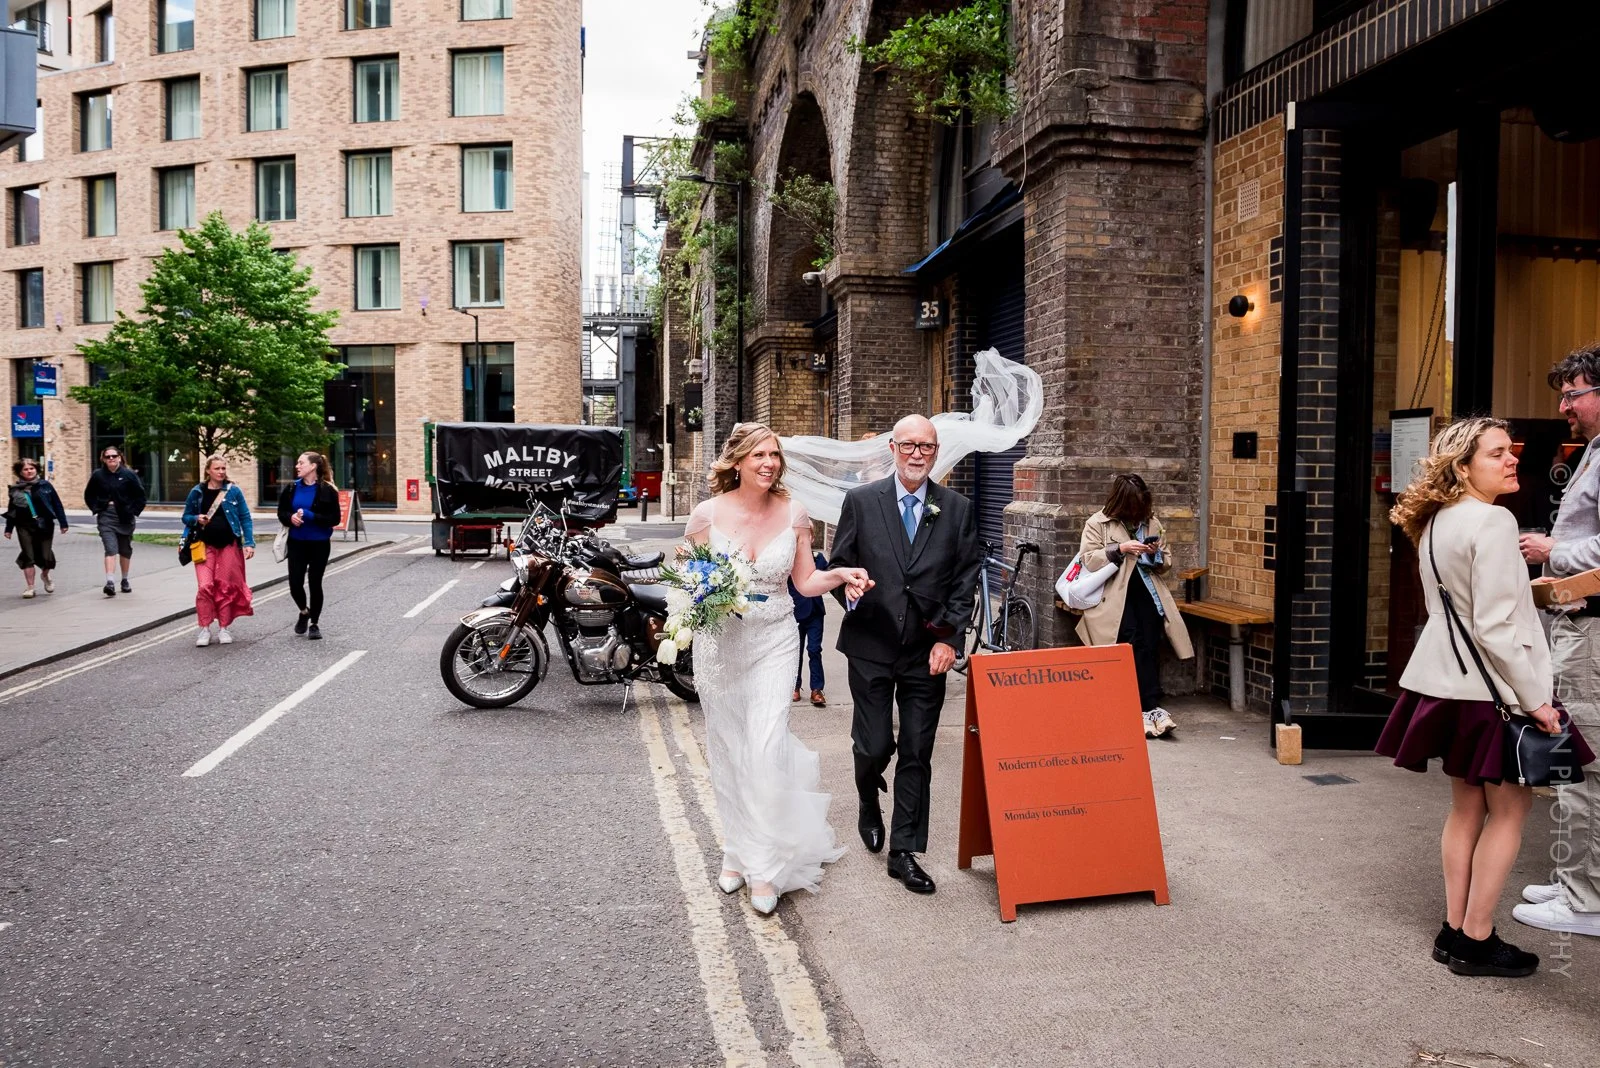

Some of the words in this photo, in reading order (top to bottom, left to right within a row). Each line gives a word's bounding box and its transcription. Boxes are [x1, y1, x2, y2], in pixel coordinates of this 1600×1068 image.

[921, 301, 939, 319] 35
[813, 353, 826, 365] 34
[483, 445, 577, 469] MALTBY
[508, 468, 553, 477] STREET
[484, 474, 576, 493] MARKET
[987, 669, 1094, 687] WatchHouse.
[998, 759, 1037, 771] Modern
[1038, 756, 1069, 768] Coffee
[1071, 756, 1078, 765] &
[1080, 752, 1125, 764] Roastery.
[1004, 810, 1041, 821] Monday
[1042, 810, 1052, 818] to
[1052, 806, 1088, 817] Sunday.
